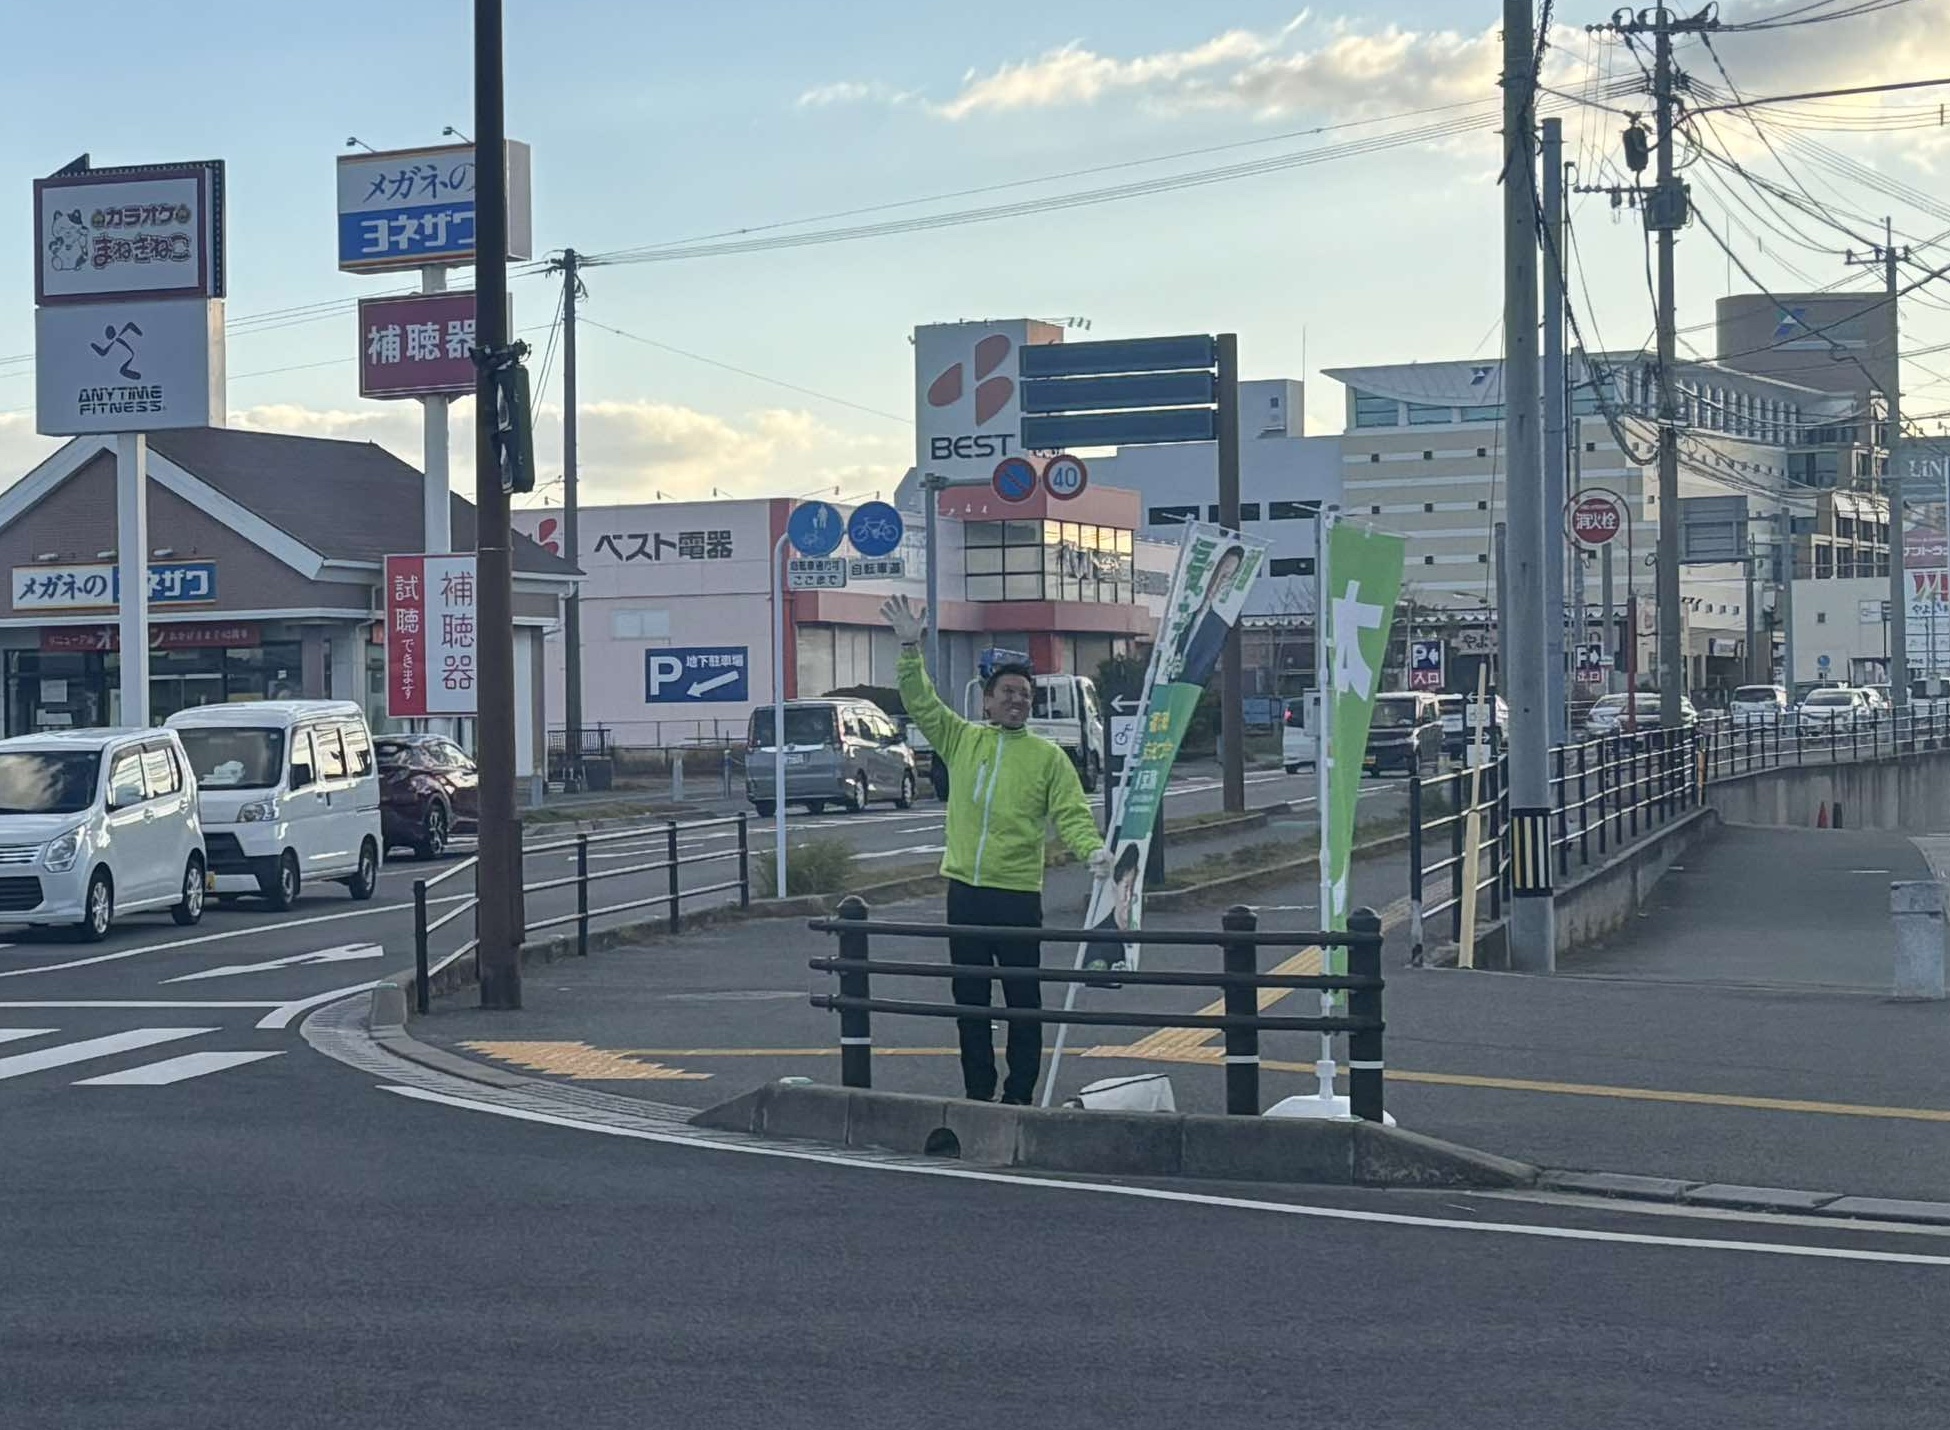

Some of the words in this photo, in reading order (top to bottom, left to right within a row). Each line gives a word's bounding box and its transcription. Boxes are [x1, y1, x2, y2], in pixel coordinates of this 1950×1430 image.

[363, 162, 476, 203] メガネの
[106, 204, 175, 229] カラオケ
[360, 209, 476, 253] ヨネザワ
[92, 233, 190, 270] まねきねこ
[368, 319, 476, 367] 補聴器
[78, 385, 162, 403] ANYTIME
[80, 400, 162, 415] FITNESS
[931, 433, 1015, 460] BEST
[1053, 466, 1078, 488] 40
[1575, 511, 1617, 530] 消火栓
[594, 530, 733, 562] ベスト電器
[19, 574, 108, 600] メガネの
[394, 575, 419, 700] 試聴できます
[440, 571, 475, 690] 補聴器
[686, 654, 744, 669] 地下駐車場
[1412, 643, 1428, 669] P
[650, 656, 683, 696] P
[1413, 672, 1441, 685] 入口
